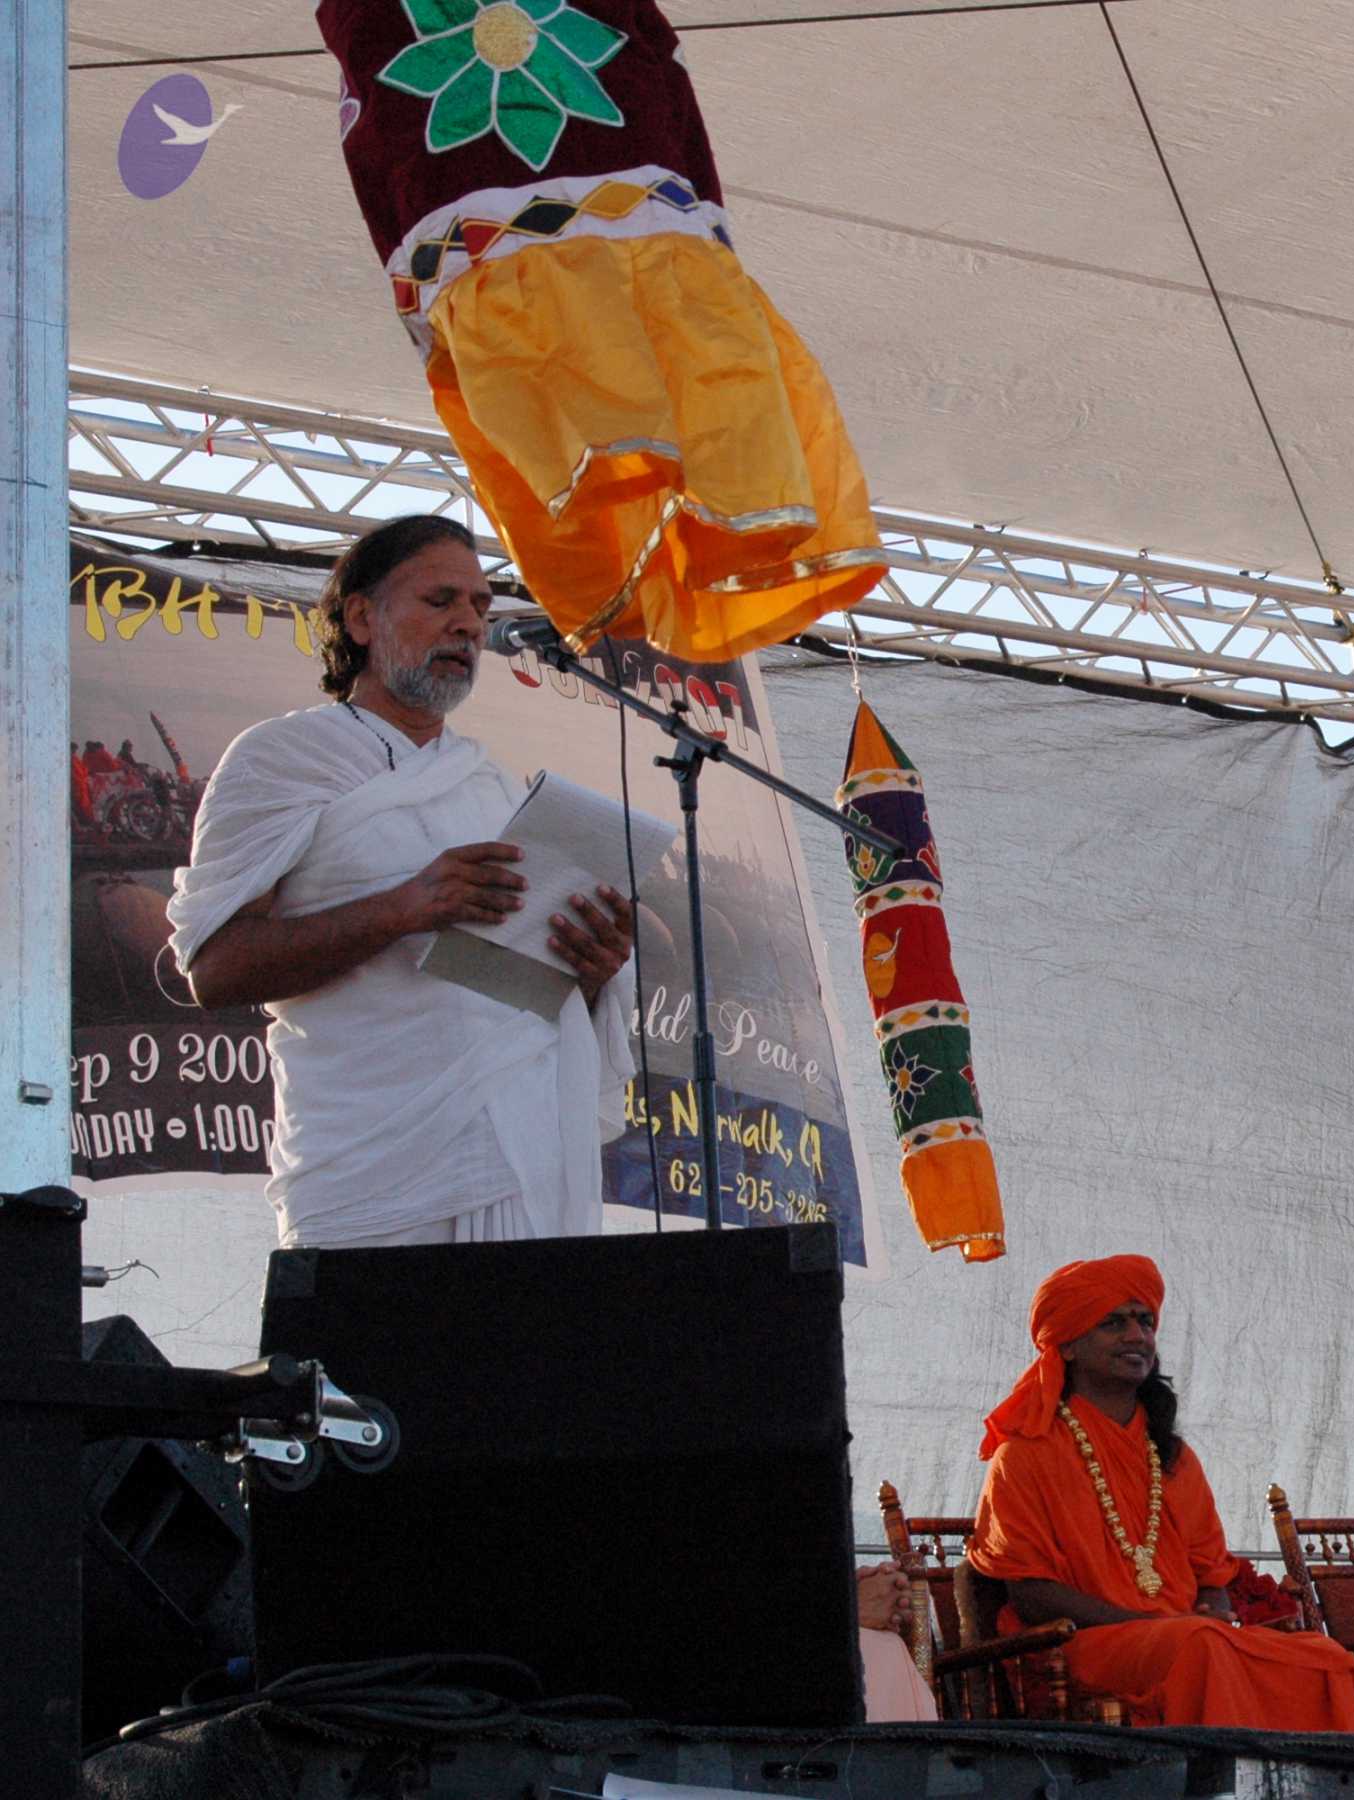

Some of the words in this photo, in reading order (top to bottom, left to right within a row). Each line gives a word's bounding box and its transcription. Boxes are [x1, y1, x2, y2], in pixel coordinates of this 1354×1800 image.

[128, 1033, 160, 1083] 9
[178, 1033, 267, 1084] 200
[671, 1079, 793, 1168] Nrwalk,
